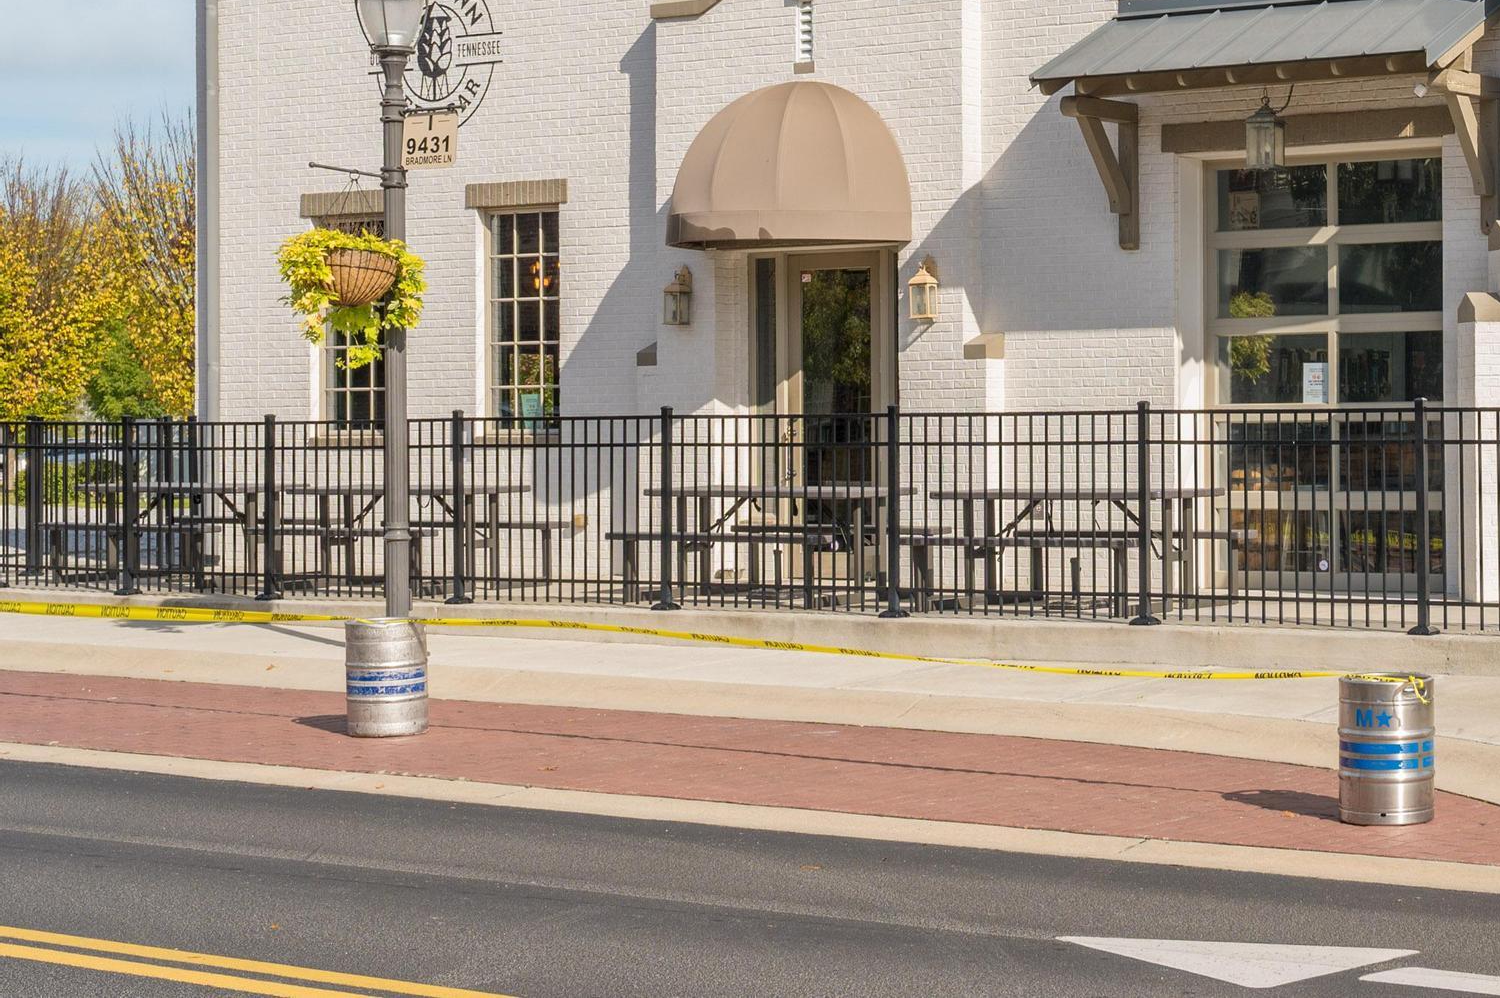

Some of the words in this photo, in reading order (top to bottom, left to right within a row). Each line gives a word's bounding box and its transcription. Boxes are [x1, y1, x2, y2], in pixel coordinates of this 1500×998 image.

[457, 40, 501, 58] TENNESSEE
[406, 135, 450, 155] 9431
[405, 154, 442, 166] BRADMORE
[443, 153, 453, 163] LN
